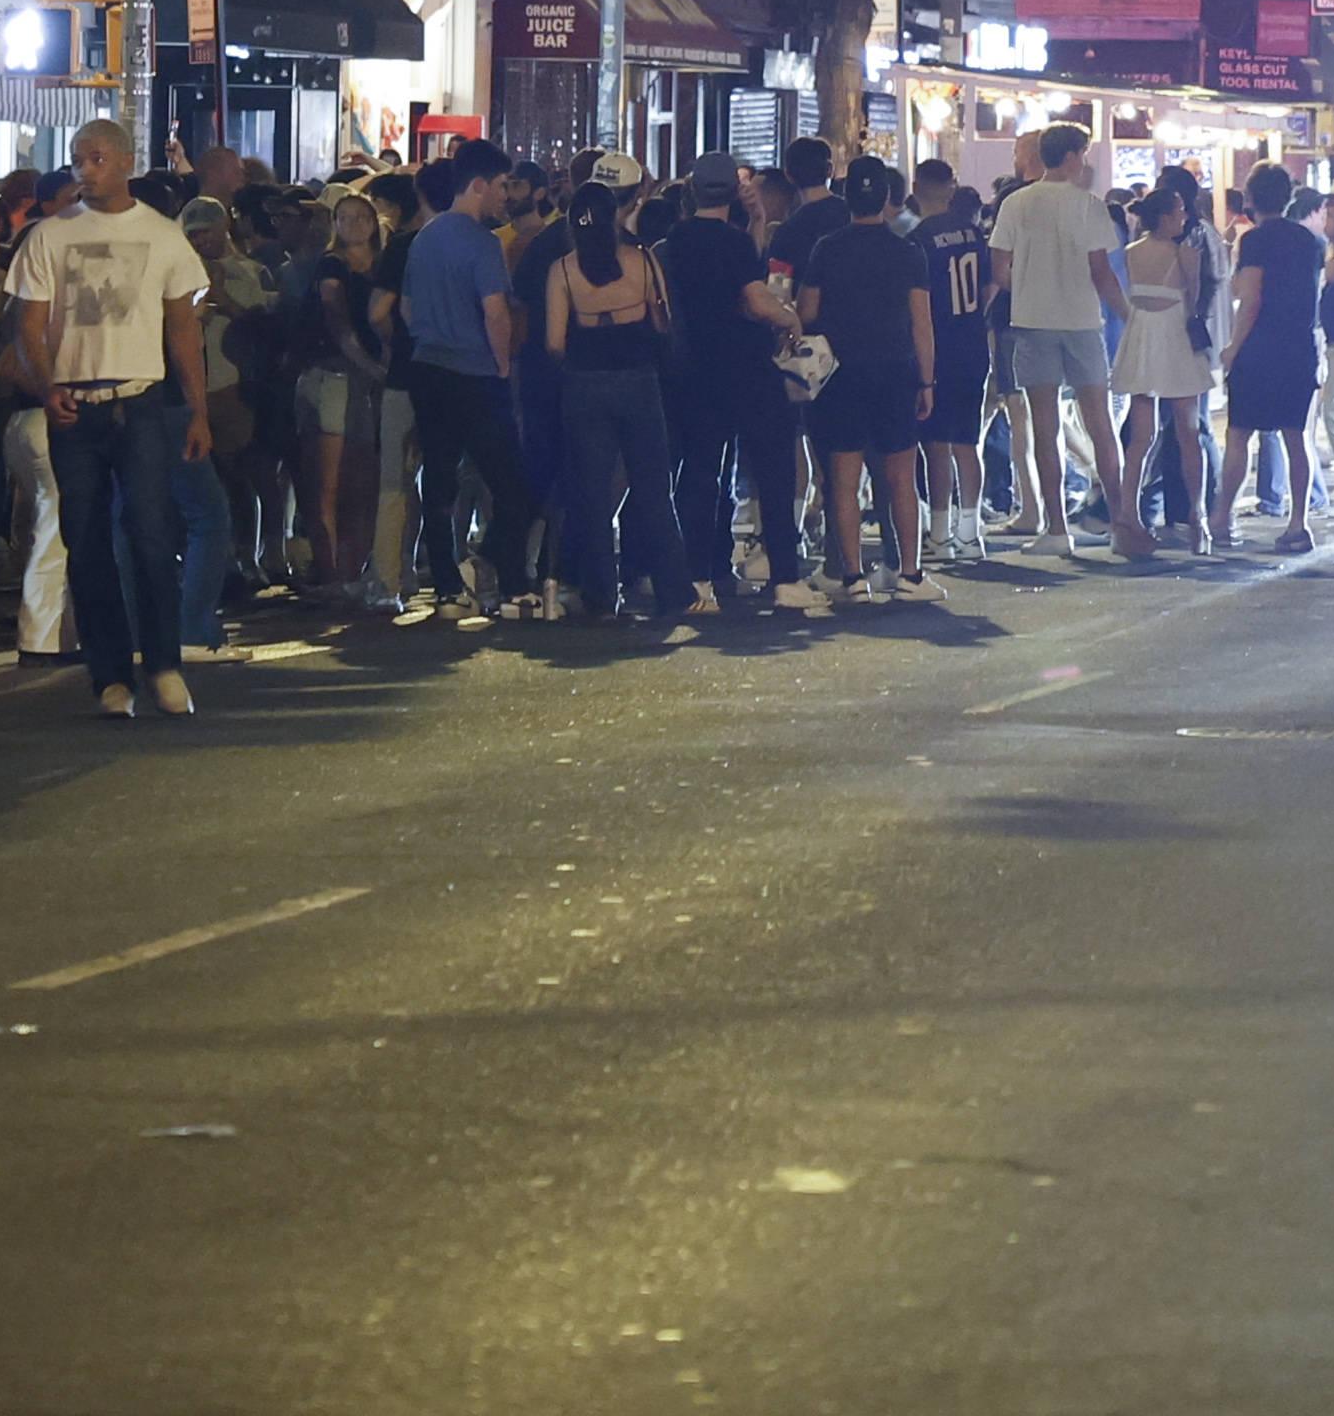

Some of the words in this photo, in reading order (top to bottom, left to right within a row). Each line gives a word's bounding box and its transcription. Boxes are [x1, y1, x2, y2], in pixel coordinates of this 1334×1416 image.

[525, 4, 575, 17] ORGANIC
[526, 18, 574, 33] JUICE
[533, 34, 568, 48] BAR
[1219, 62, 1260, 74] GLASS
[1262, 64, 1288, 76] CUT
[1219, 76, 1251, 89] TOOL
[1253, 78, 1299, 91] RENTAL
[948, 251, 978, 316] 10
